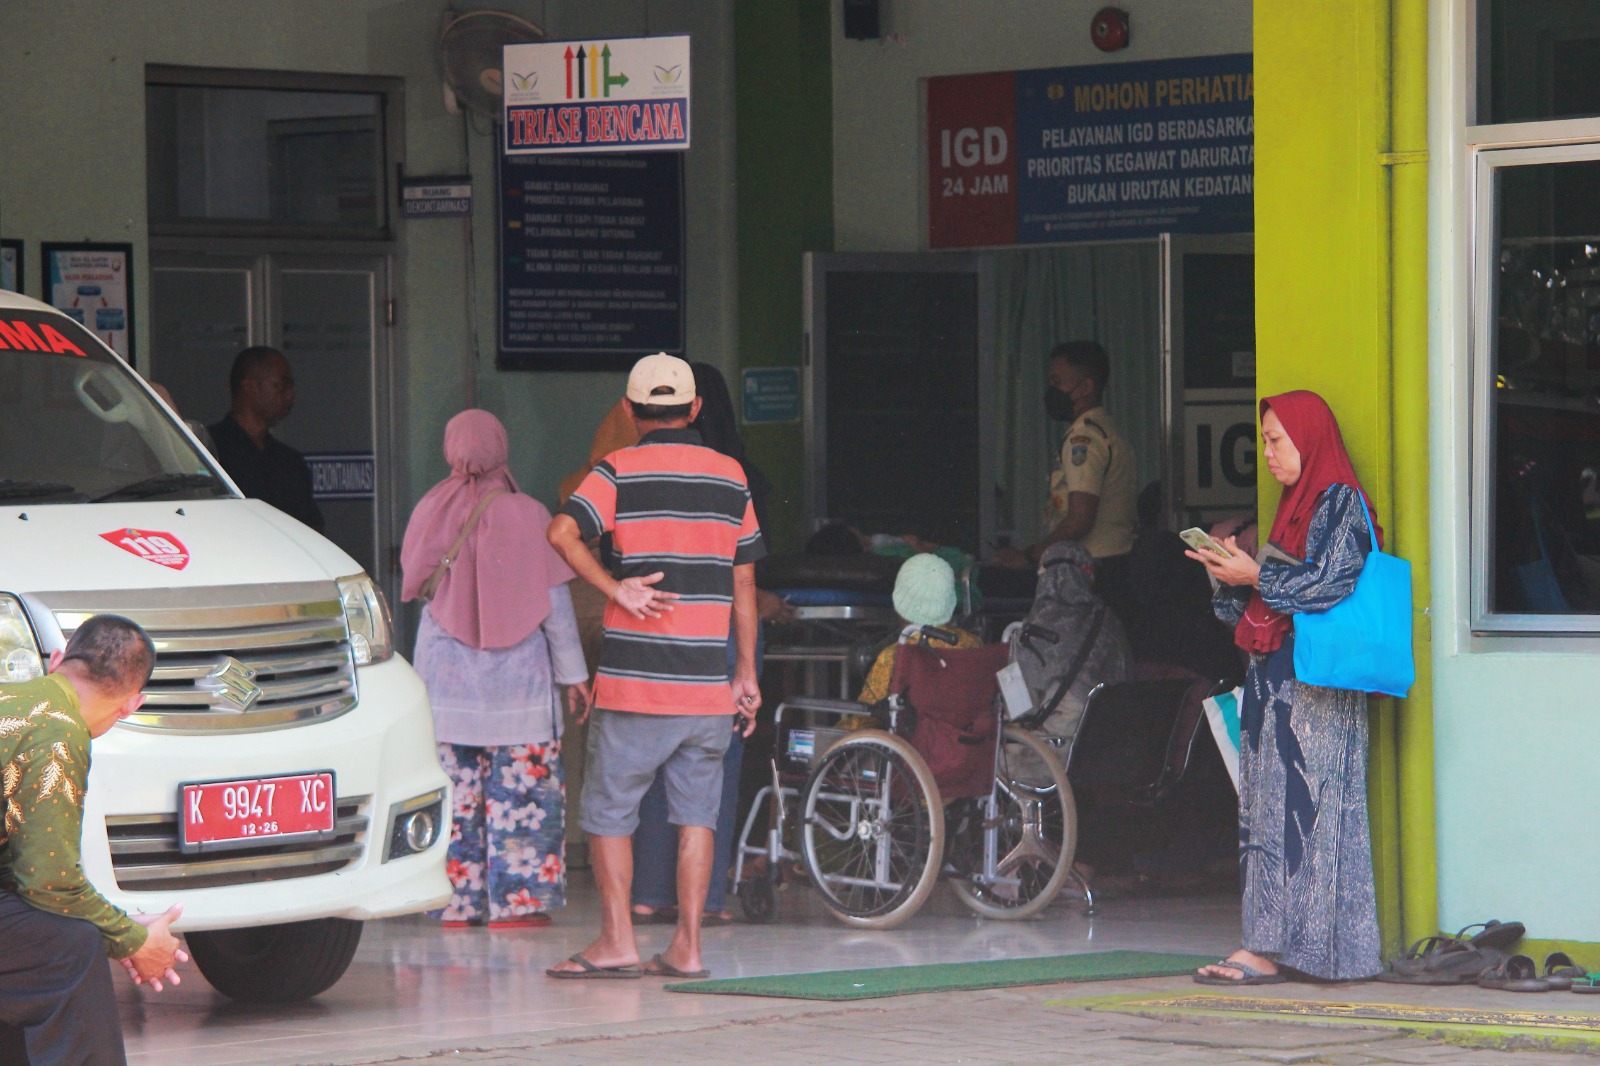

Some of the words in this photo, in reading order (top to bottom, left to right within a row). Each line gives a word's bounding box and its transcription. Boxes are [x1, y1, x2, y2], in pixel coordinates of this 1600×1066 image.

[1075, 83, 1149, 112] MOHON
[510, 107, 581, 145] TRIASE
[586, 102, 684, 142] BENCANA
[1043, 126, 1123, 149] PELAYANAN
[1128, 123, 1153, 143] IGD
[941, 126, 1008, 167] IGD
[1028, 155, 1101, 177] PRIORITAS
[1106, 151, 1174, 173] KEGAWAT
[524, 195, 566, 205] PRIORITAS
[554, 182, 571, 192] DAN
[942, 177, 964, 197] 24
[970, 175, 1008, 195] JAM
[1068, 183, 1116, 204] BUKAN
[1121, 179, 1180, 201] URUTAN
[1185, 175, 1254, 197] KEDATAN
[407, 199, 468, 213] DEKONTAMINASI
[0, 320, 88, 357] MA
[1197, 423, 1256, 488] IG
[313, 462, 372, 491] DEKONTAMINASI
[120, 536, 180, 555] 119
[190, 790, 204, 824] K
[223, 783, 275, 819] 9947
[300, 779, 326, 813] XC
